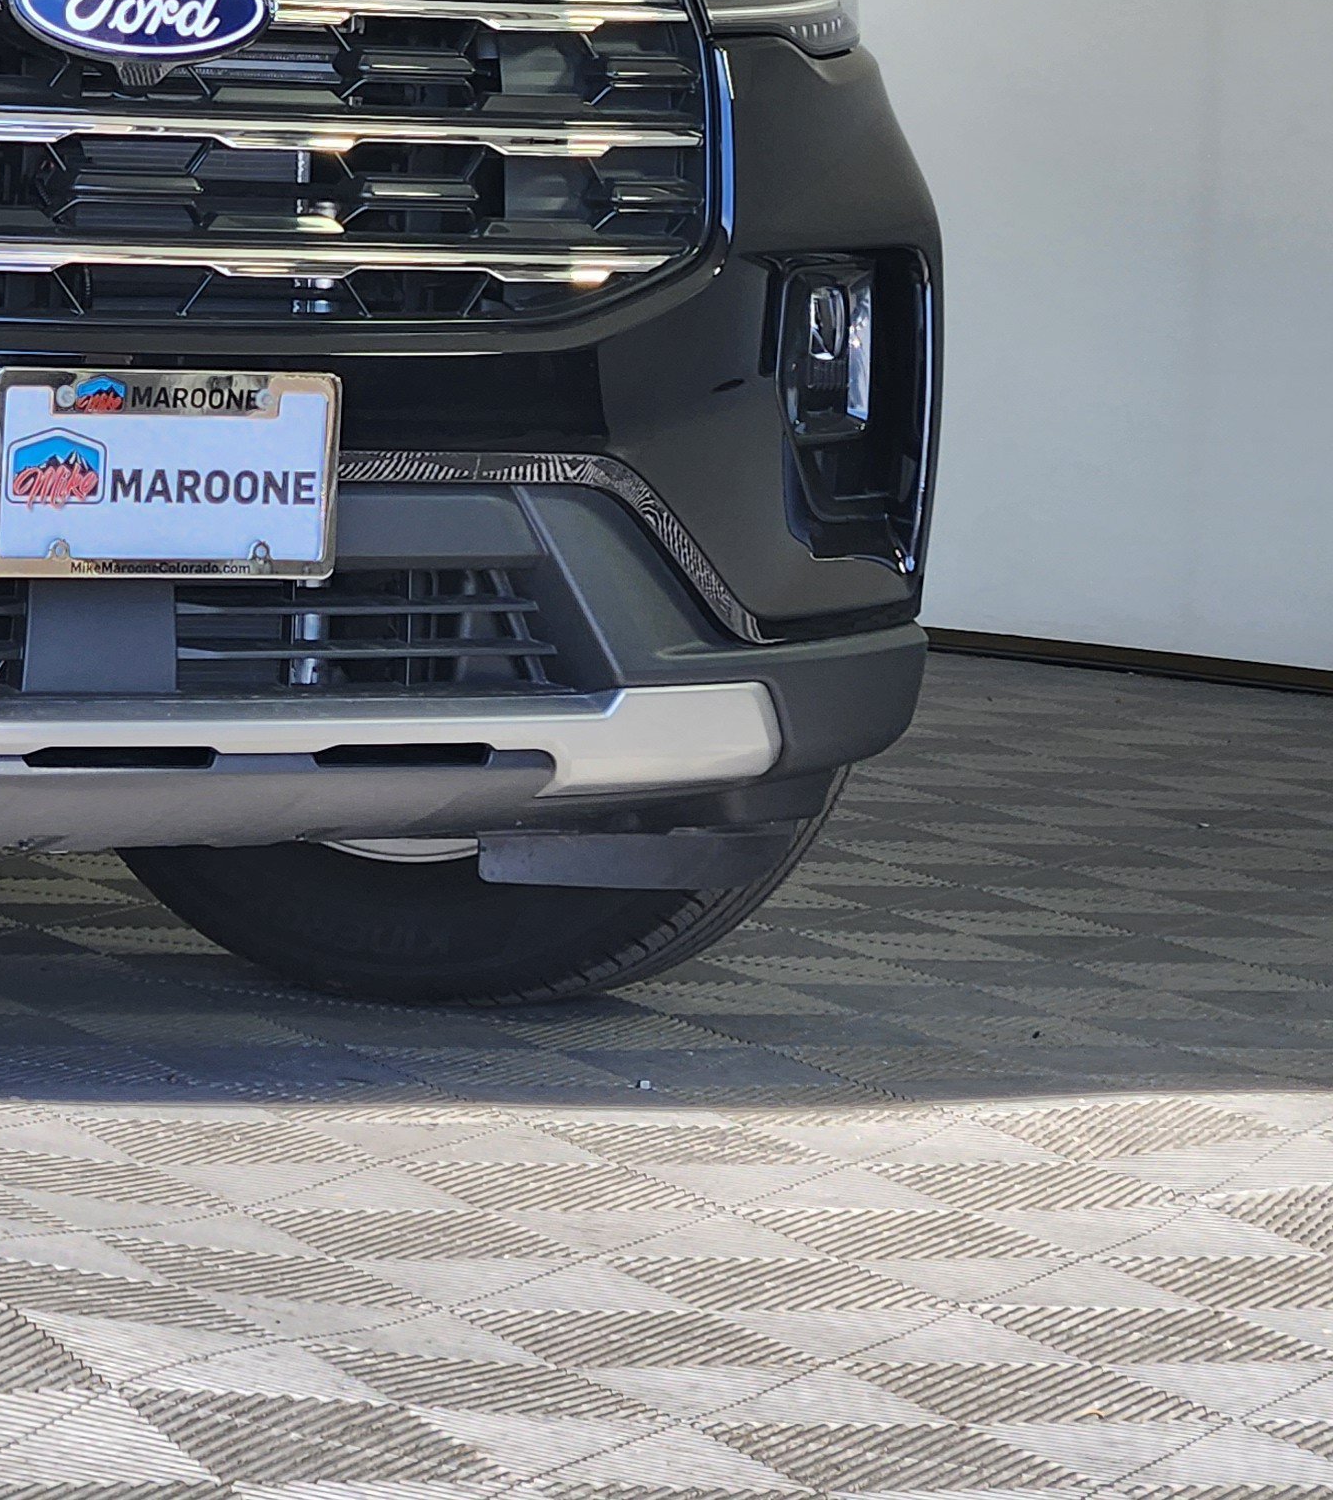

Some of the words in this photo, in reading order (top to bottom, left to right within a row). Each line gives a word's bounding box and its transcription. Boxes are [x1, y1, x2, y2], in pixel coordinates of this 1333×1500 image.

[132, 385, 259, 410] MAROONE
[13, 464, 99, 511] Mike
[109, 468, 318, 505] MAROONE
[70, 560, 251, 575] MikeMarooneColorado.com
